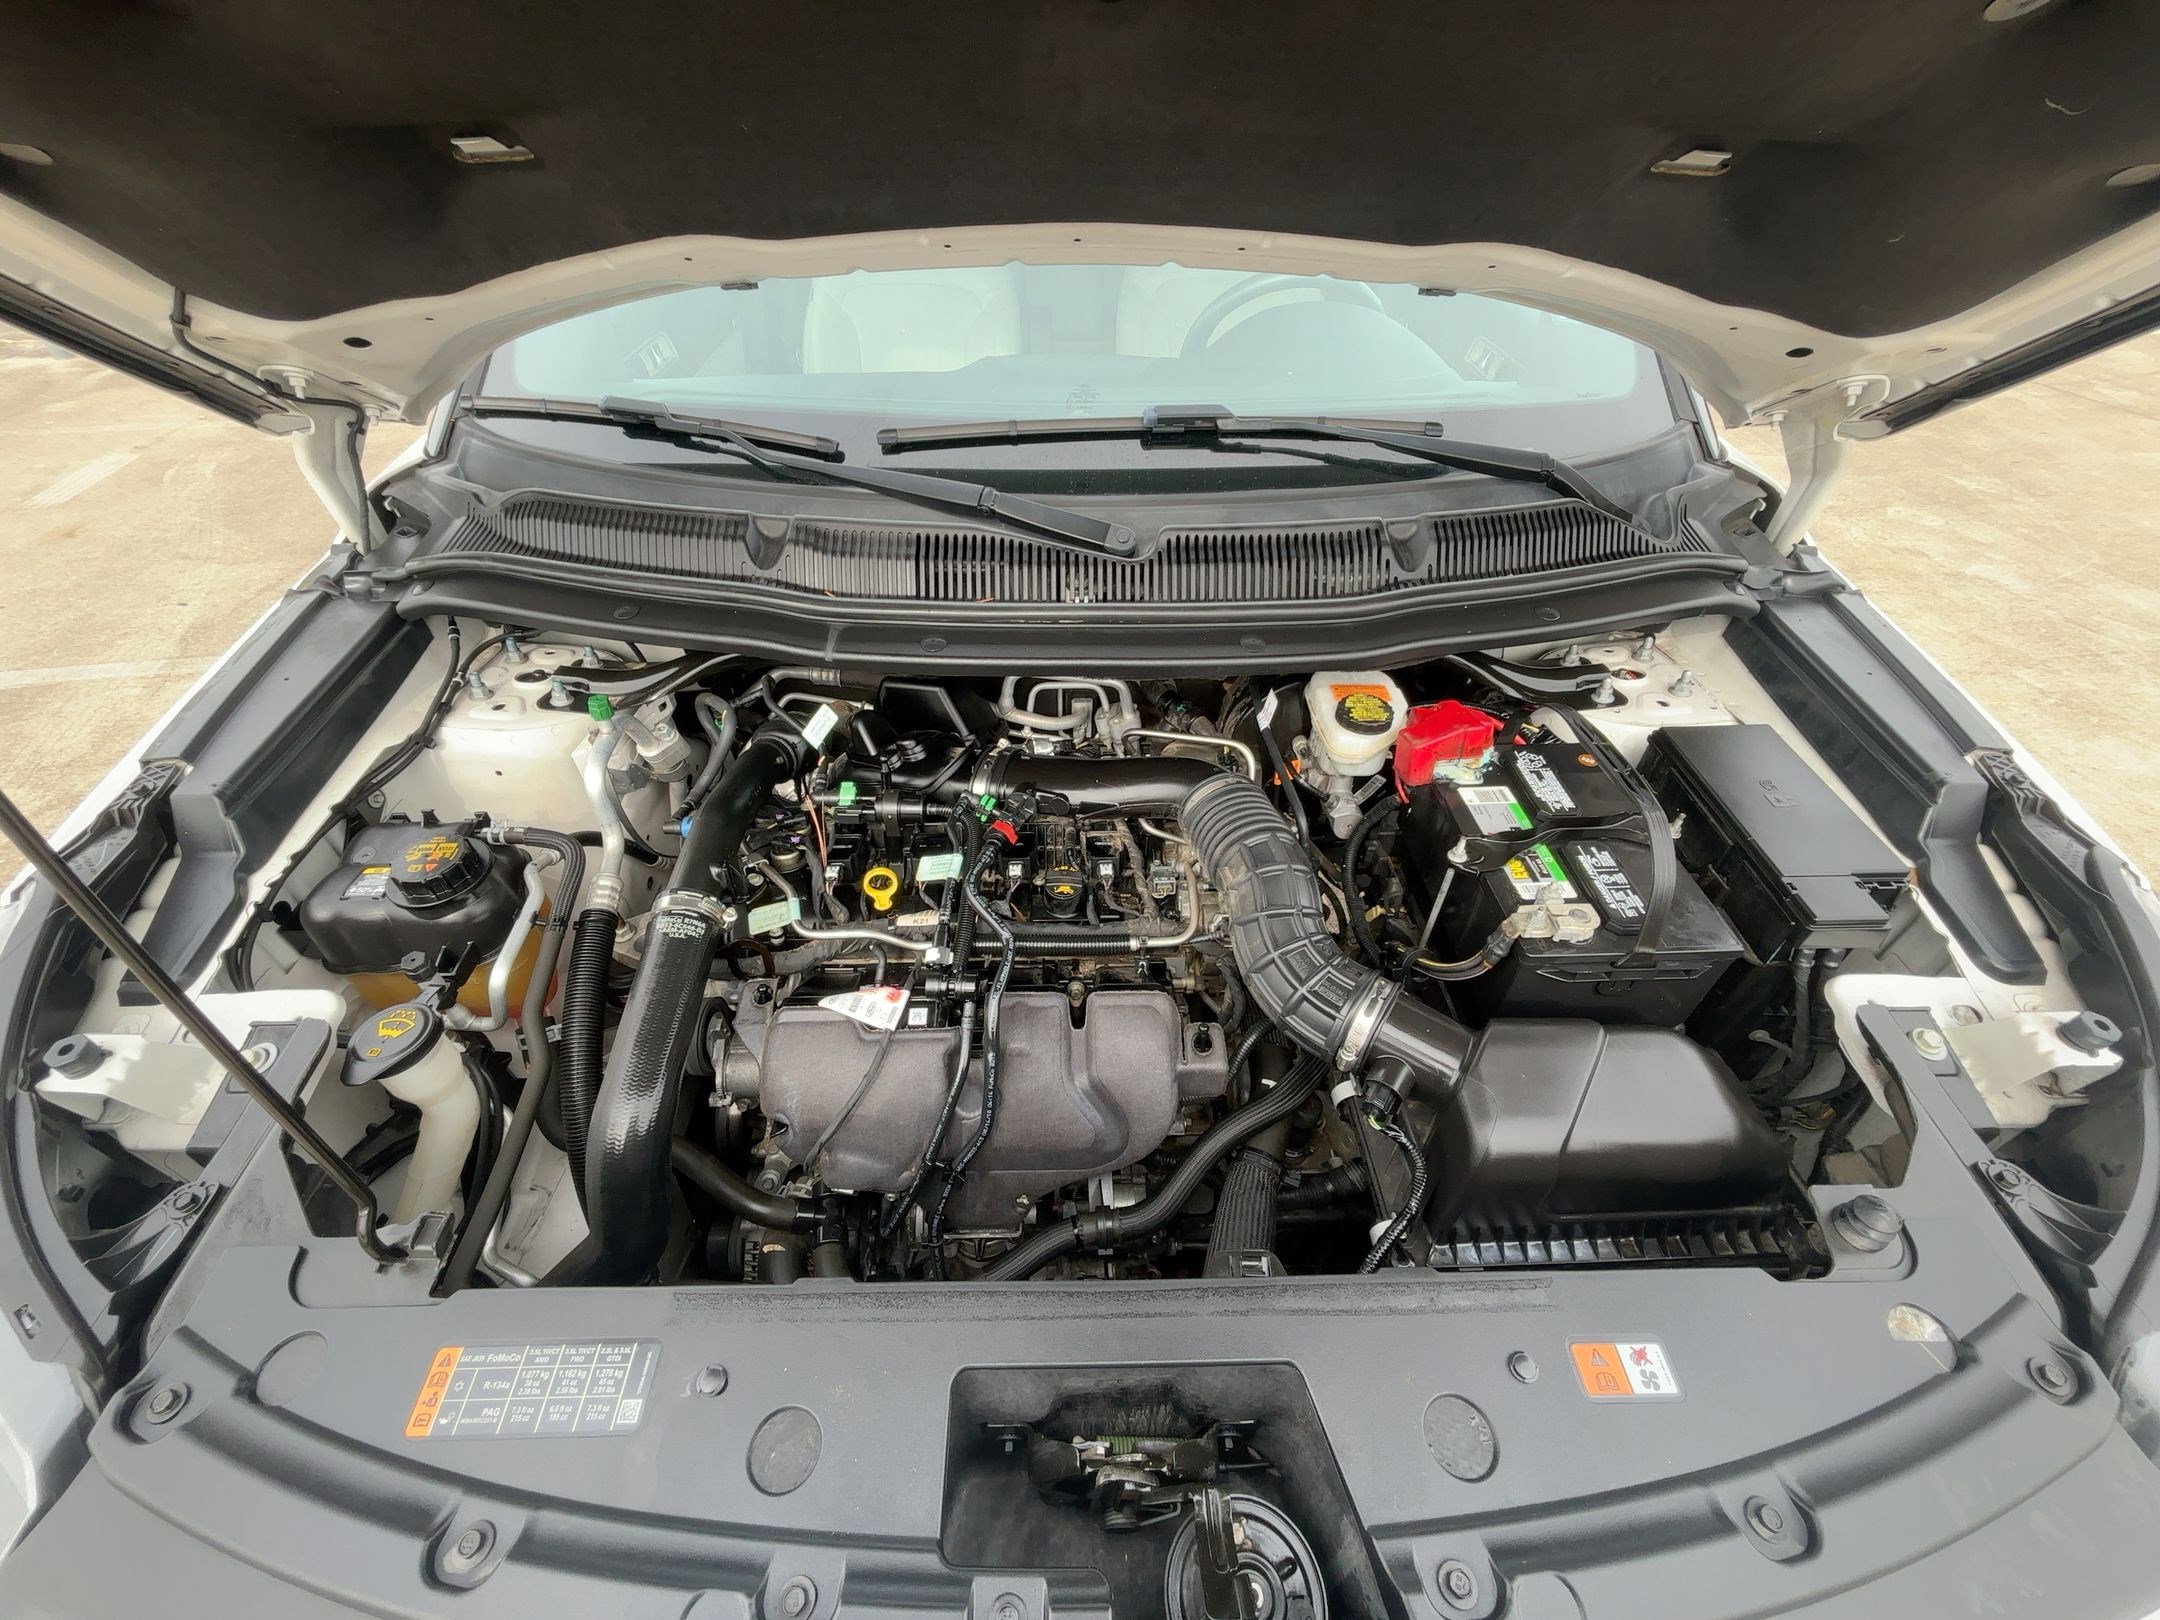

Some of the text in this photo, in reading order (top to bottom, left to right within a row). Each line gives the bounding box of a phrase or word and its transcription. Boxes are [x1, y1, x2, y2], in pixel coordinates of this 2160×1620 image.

[487, 1353, 521, 1363] FoMoCo
[522, 1370, 550, 1380] 1.077 kg
[559, 1370, 588, 1379] 1.162 kg
[596, 1368, 624, 1378] 1.276 kg
[483, 1381, 510, 1390] R-134a
[482, 1408, 500, 1417] PAG
[512, 1406, 522, 1414] 7.3
[587, 1404, 598, 1412] 7.3
